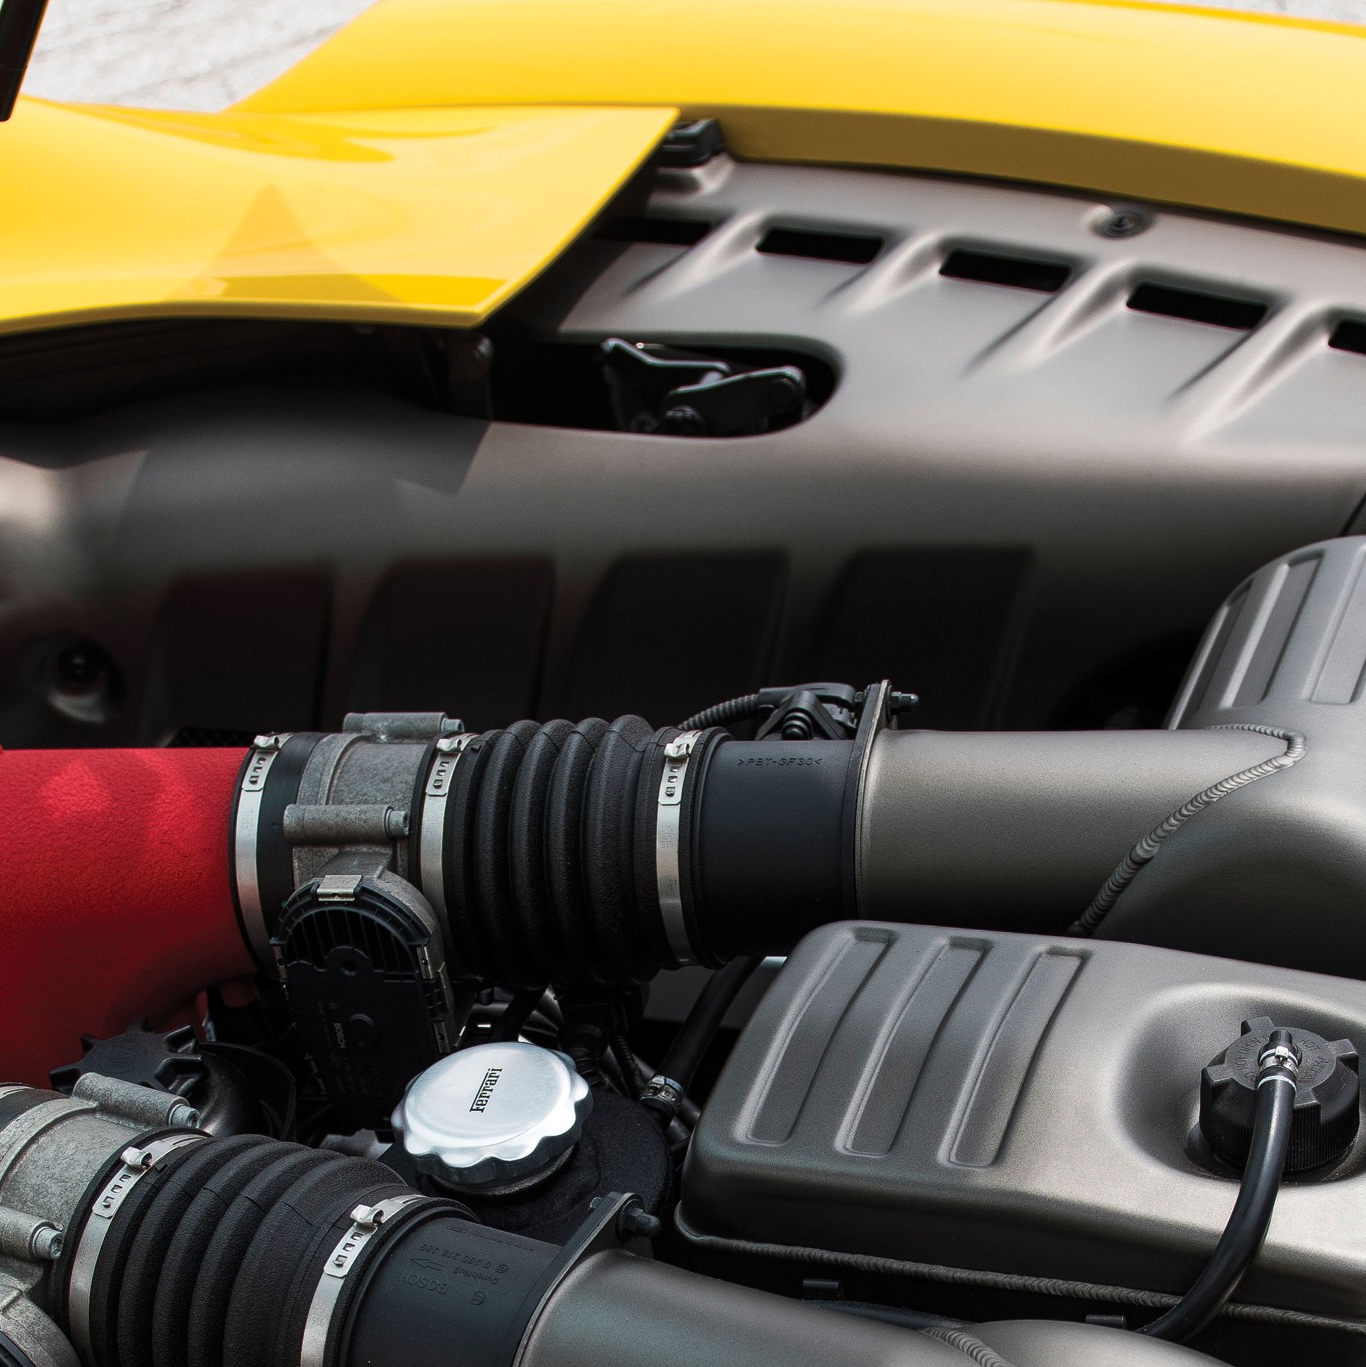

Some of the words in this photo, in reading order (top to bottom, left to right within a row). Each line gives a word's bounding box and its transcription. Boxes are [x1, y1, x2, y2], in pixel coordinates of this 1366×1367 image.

[333, 1022, 347, 1049] BOSCH
[469, 1067, 503, 1114] Ferrari
[398, 1269, 450, 1295] BOSCH
